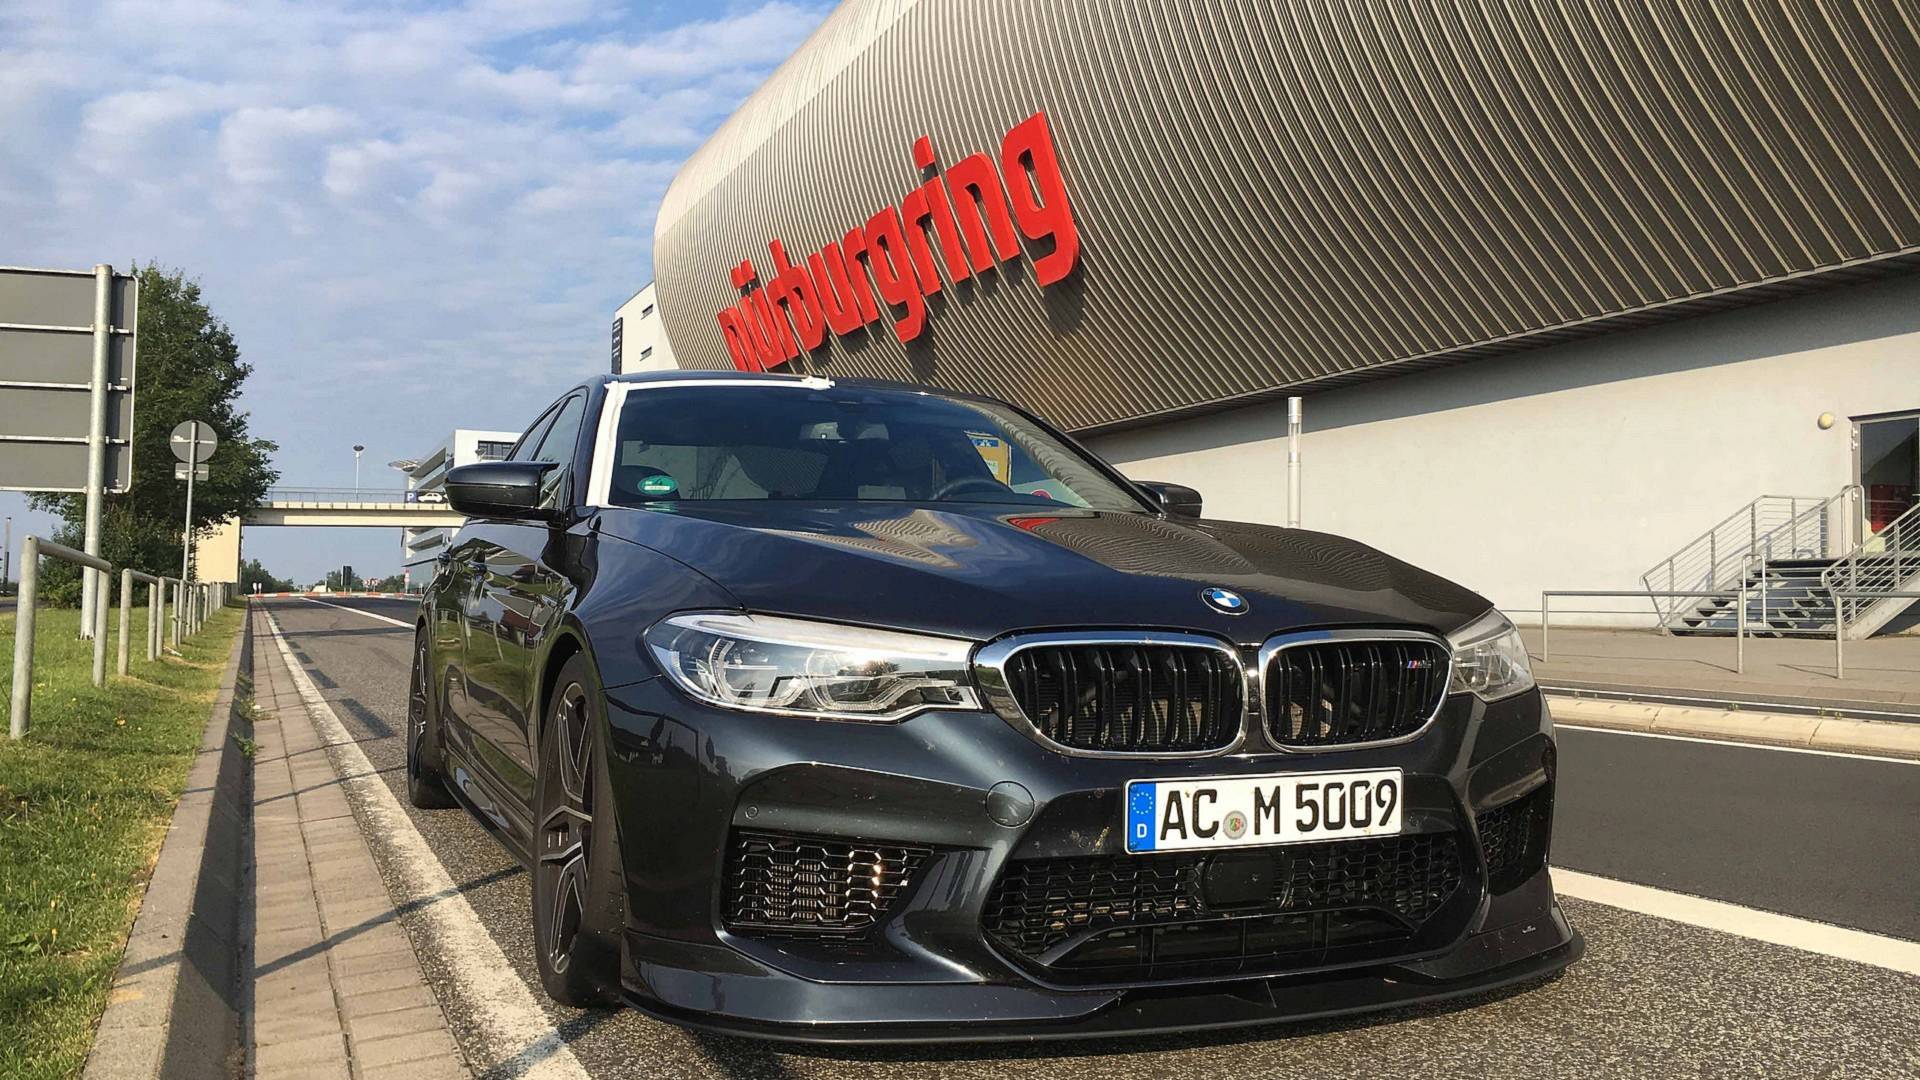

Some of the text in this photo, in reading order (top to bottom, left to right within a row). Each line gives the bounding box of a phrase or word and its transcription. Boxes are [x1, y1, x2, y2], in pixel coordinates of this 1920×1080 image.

[717, 112, 1079, 371] nürburgring
[407, 493, 415, 502] P
[1160, 779, 1398, 841] AC M 5009
[1136, 823, 1147, 839] D
